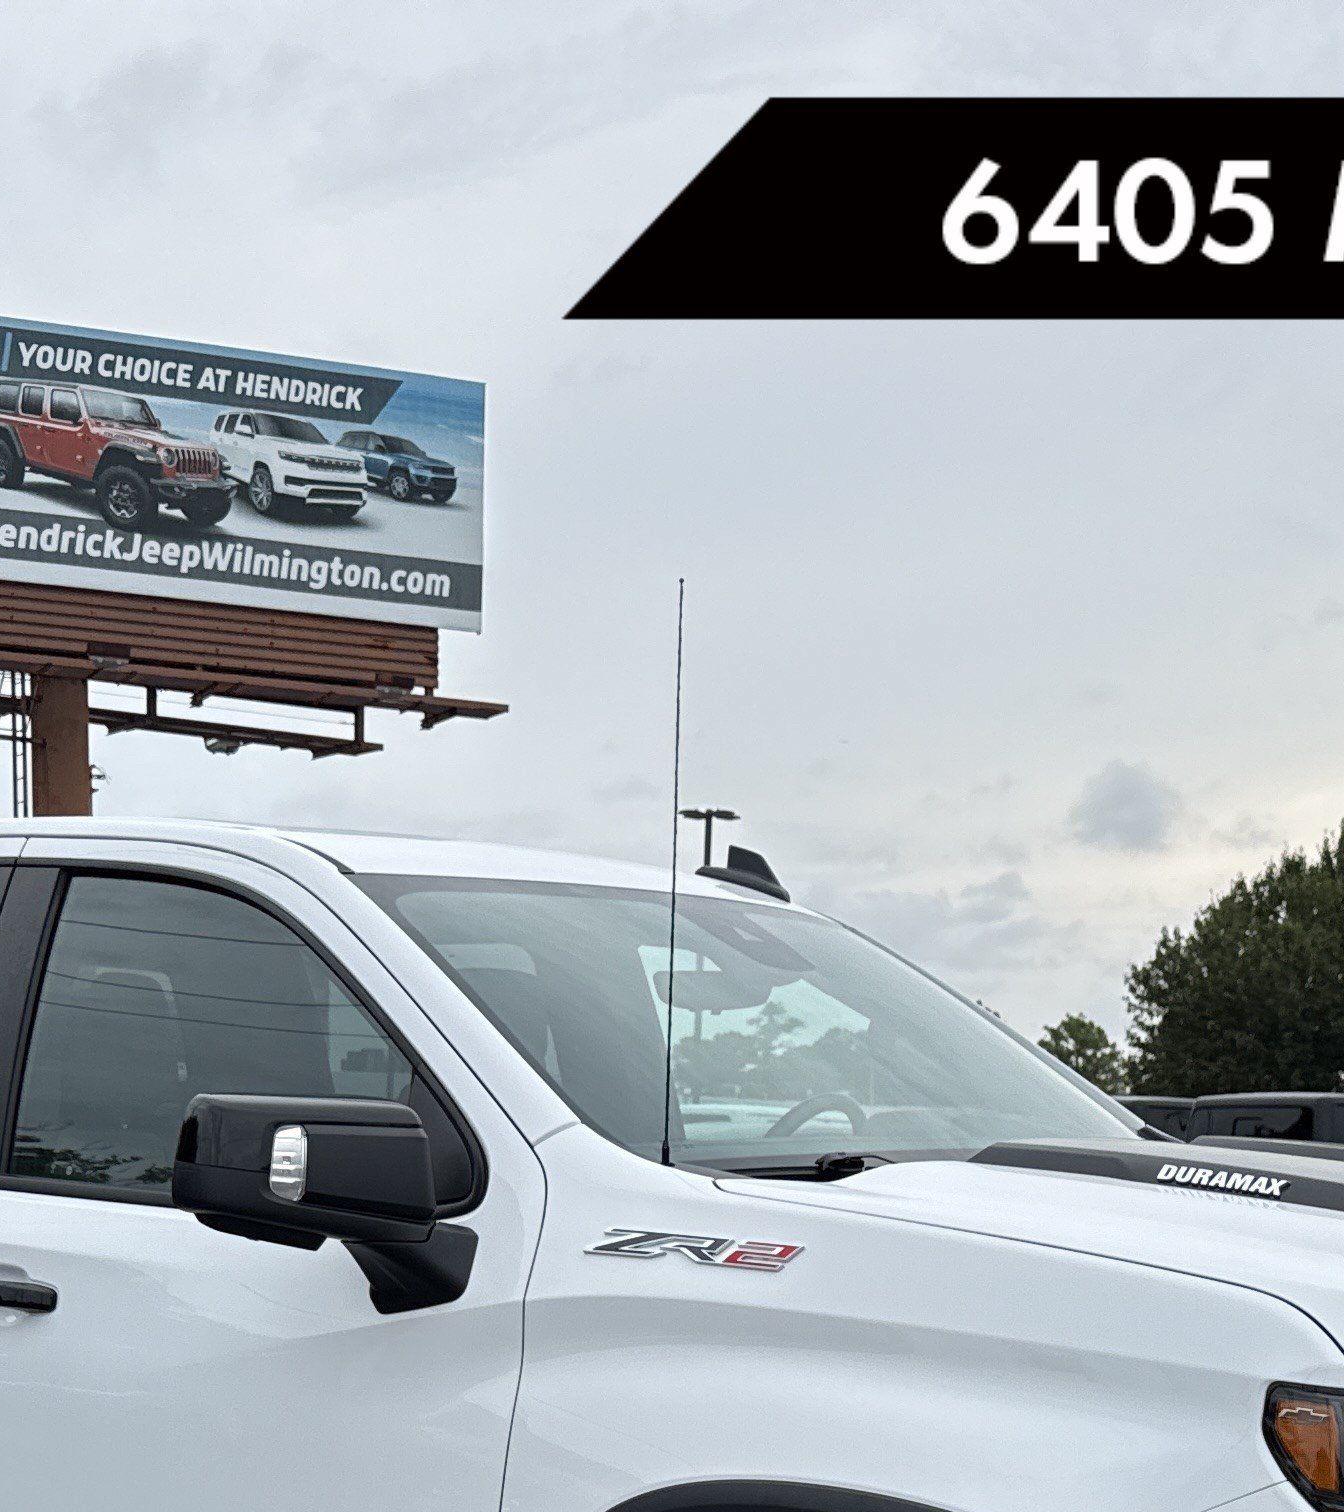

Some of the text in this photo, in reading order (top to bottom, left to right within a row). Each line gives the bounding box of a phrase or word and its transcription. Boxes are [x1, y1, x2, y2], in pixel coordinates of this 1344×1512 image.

[17, 341, 91, 375] YOUR
[97, 353, 193, 388] CHOICE
[196, 367, 233, 393] AT
[235, 371, 364, 412] HENDRICK
[1156, 1163, 1289, 1197] DURAMAX
[584, 1226, 805, 1273] ZR2
